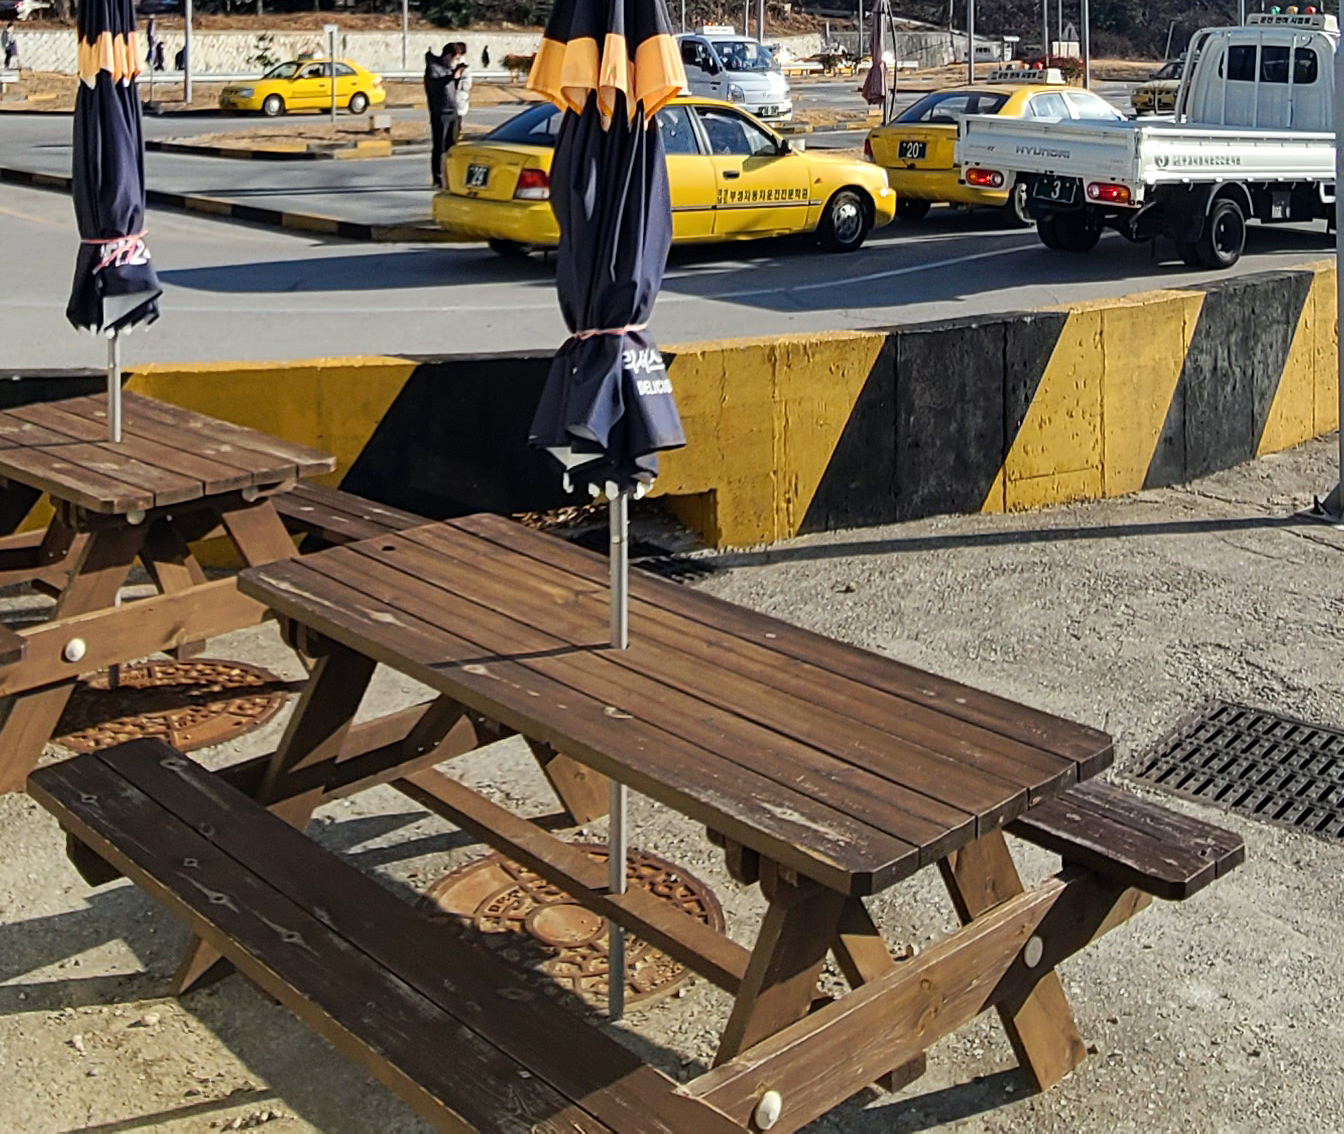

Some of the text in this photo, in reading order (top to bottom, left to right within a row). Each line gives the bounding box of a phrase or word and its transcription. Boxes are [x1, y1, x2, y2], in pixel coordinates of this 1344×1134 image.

[906, 142, 919, 158] 20
[1015, 145, 1070, 159] HYUNDAI
[1051, 180, 1061, 199] 3
